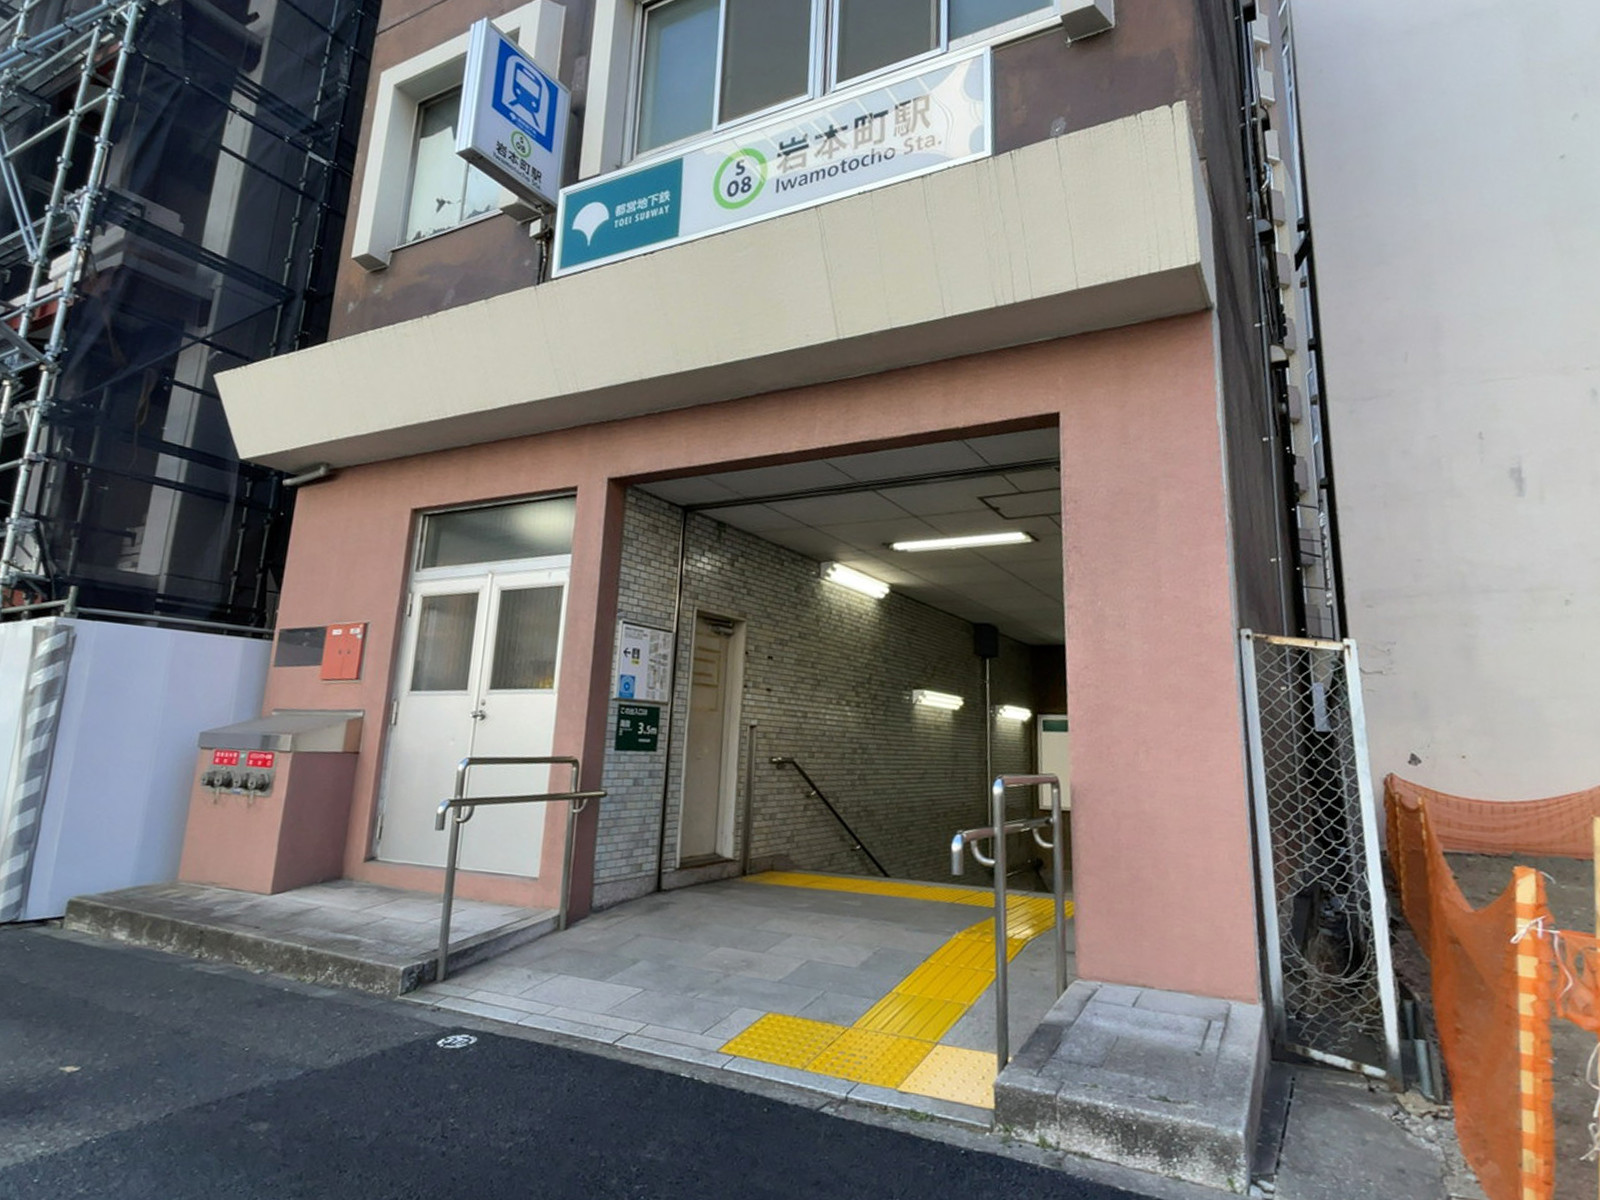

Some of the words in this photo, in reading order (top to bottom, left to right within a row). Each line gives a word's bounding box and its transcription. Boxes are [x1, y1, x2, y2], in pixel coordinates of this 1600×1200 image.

[777, 94, 932, 174] 岩本町駅
[496, 140, 542, 183] 岩本町駅
[735, 159, 746, 176] S
[775, 146, 896, 193] Iwamotocho
[903, 132, 943, 155] Sta.
[726, 176, 753, 198] 08
[614, 216, 632, 229] TOEI
[635, 204, 670, 222] SUBWAY
[615, 190, 671, 217] 都営地下鉄
